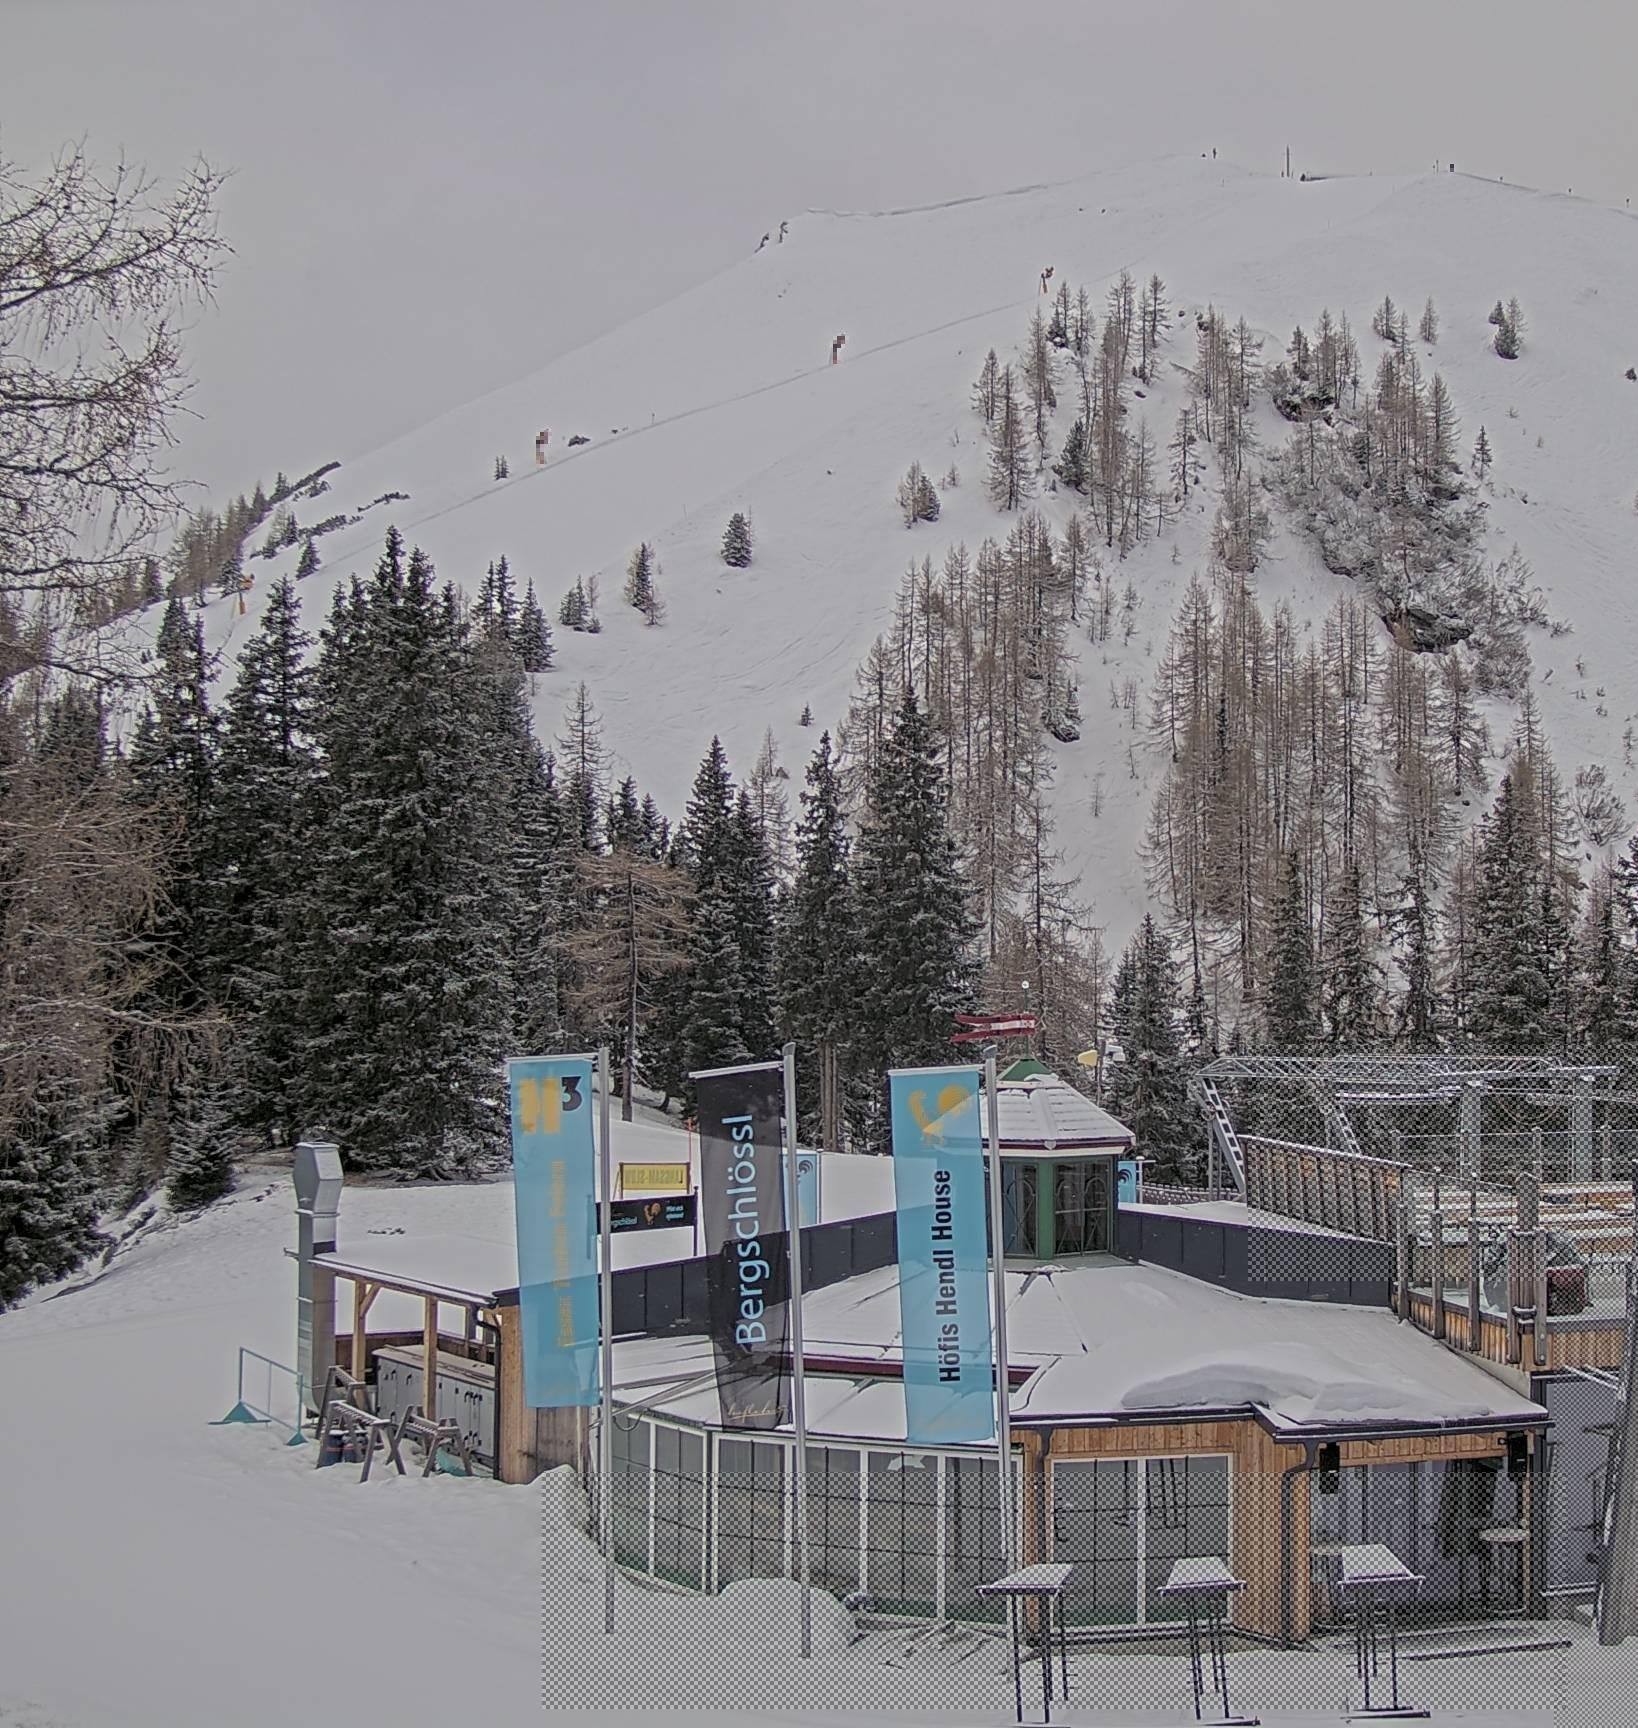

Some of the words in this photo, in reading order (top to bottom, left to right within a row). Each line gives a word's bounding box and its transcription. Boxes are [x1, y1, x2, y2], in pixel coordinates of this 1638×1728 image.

[721, 1114, 770, 1344] Bergschlössl
[931, 1170, 953, 1241] House
[933, 1249, 955, 1315] Hendl
[938, 1323, 961, 1382] Höfis
